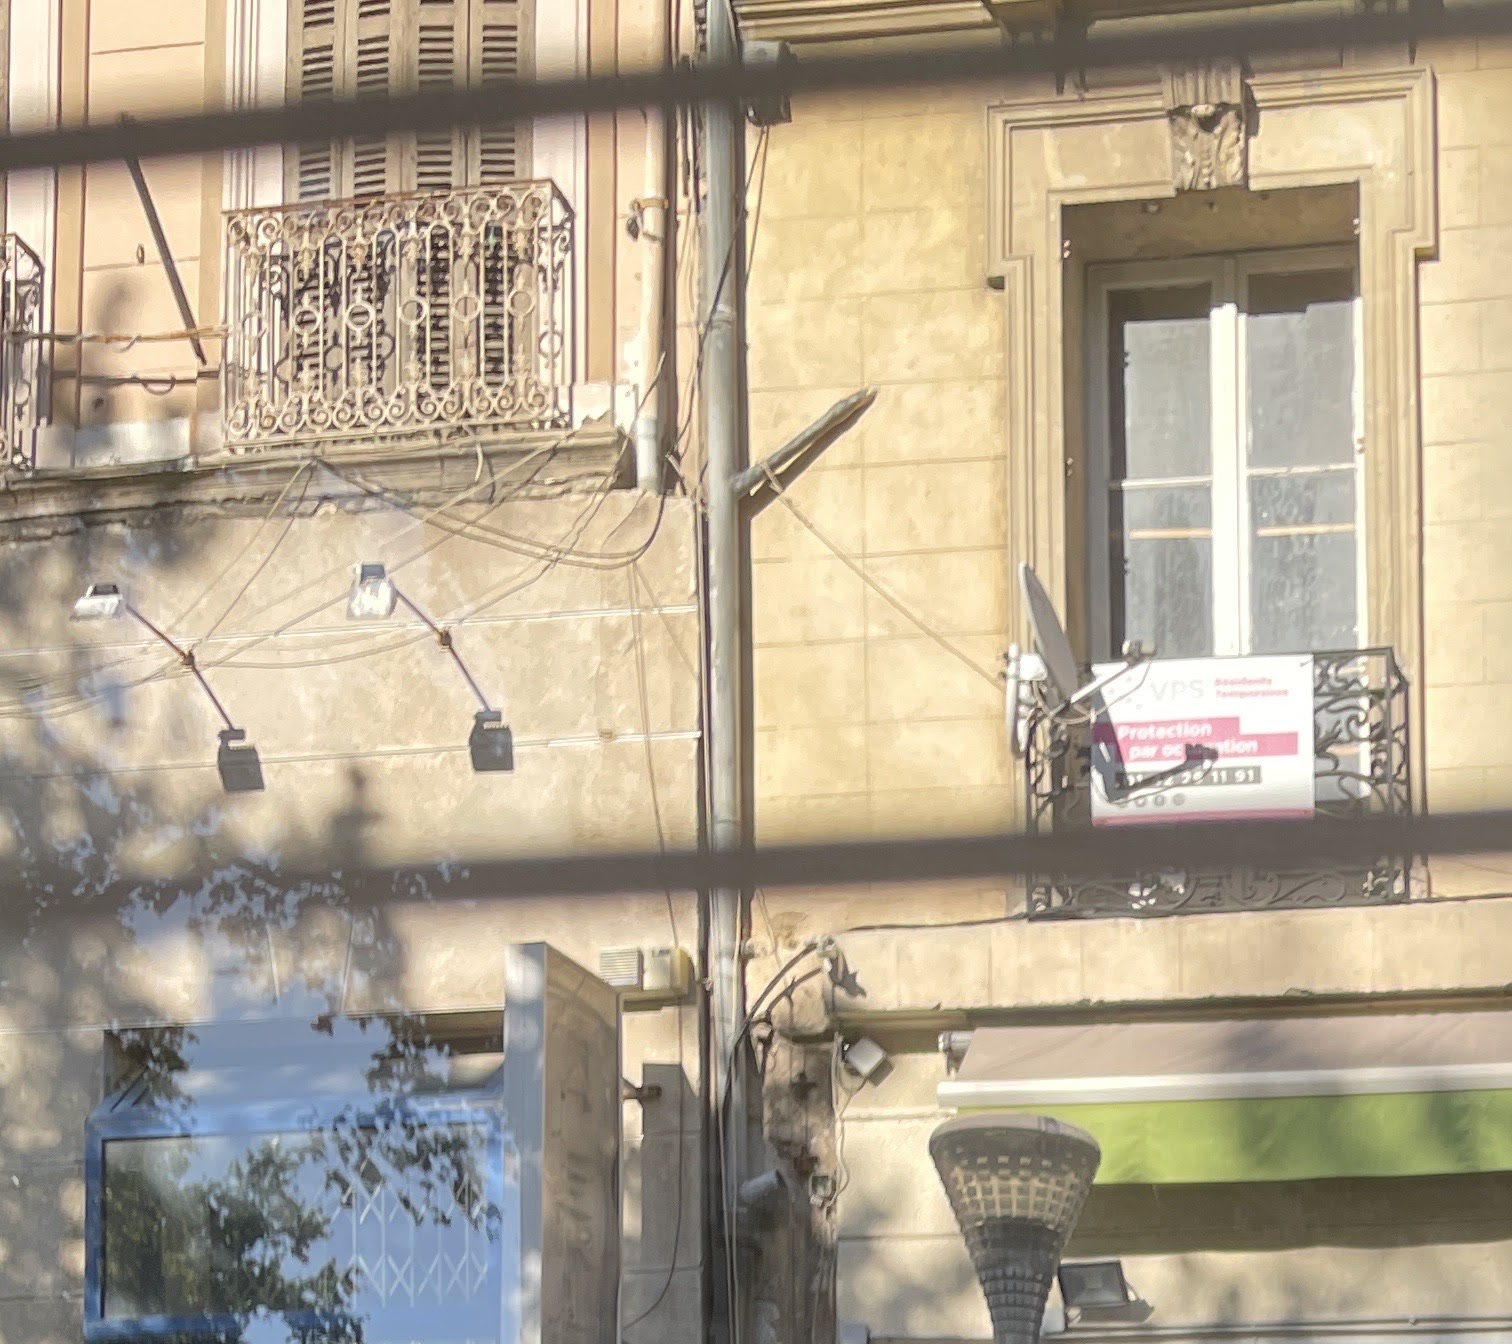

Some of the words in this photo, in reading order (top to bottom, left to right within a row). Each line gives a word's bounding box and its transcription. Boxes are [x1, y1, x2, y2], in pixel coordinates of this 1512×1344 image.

[1117, 722, 1213, 740] Protection
[1128, 744, 1159, 761] par
[1161, 739, 1259, 758] ocation
[1211, 770, 1228, 782] 11
